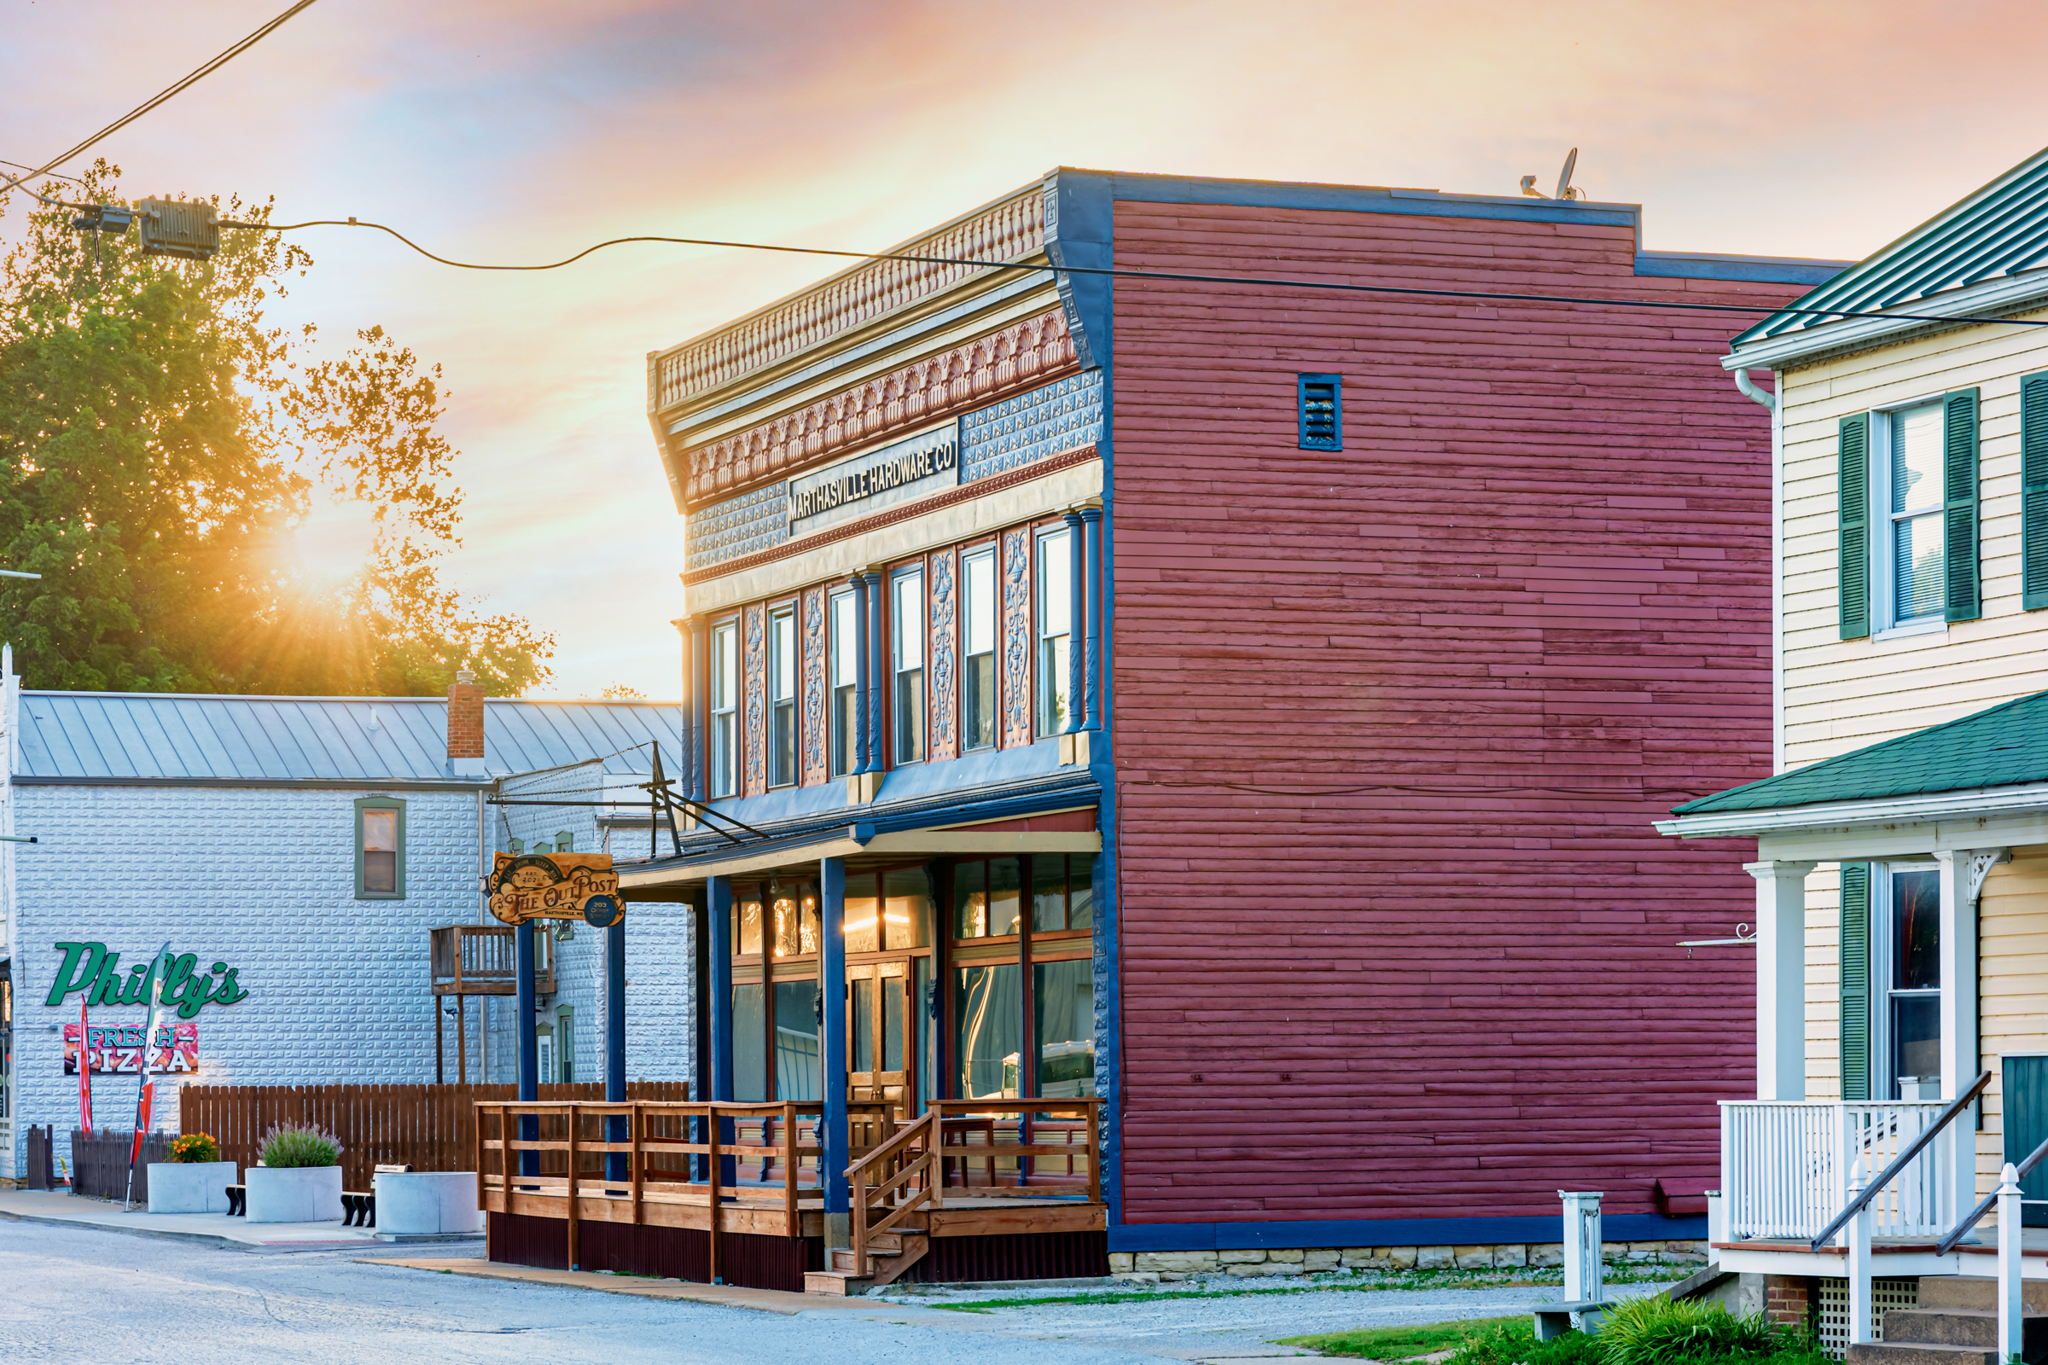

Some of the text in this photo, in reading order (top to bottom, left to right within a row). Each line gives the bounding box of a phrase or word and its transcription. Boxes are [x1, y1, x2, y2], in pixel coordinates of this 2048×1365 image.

[789, 440, 952, 520] MARTHASVILLE HARDWARE CO
[504, 892, 540, 913] THE
[45, 941, 249, 1019] Philly's
[88, 1027, 176, 1048] FRESH
[72, 1048, 192, 1073] PIZZA
